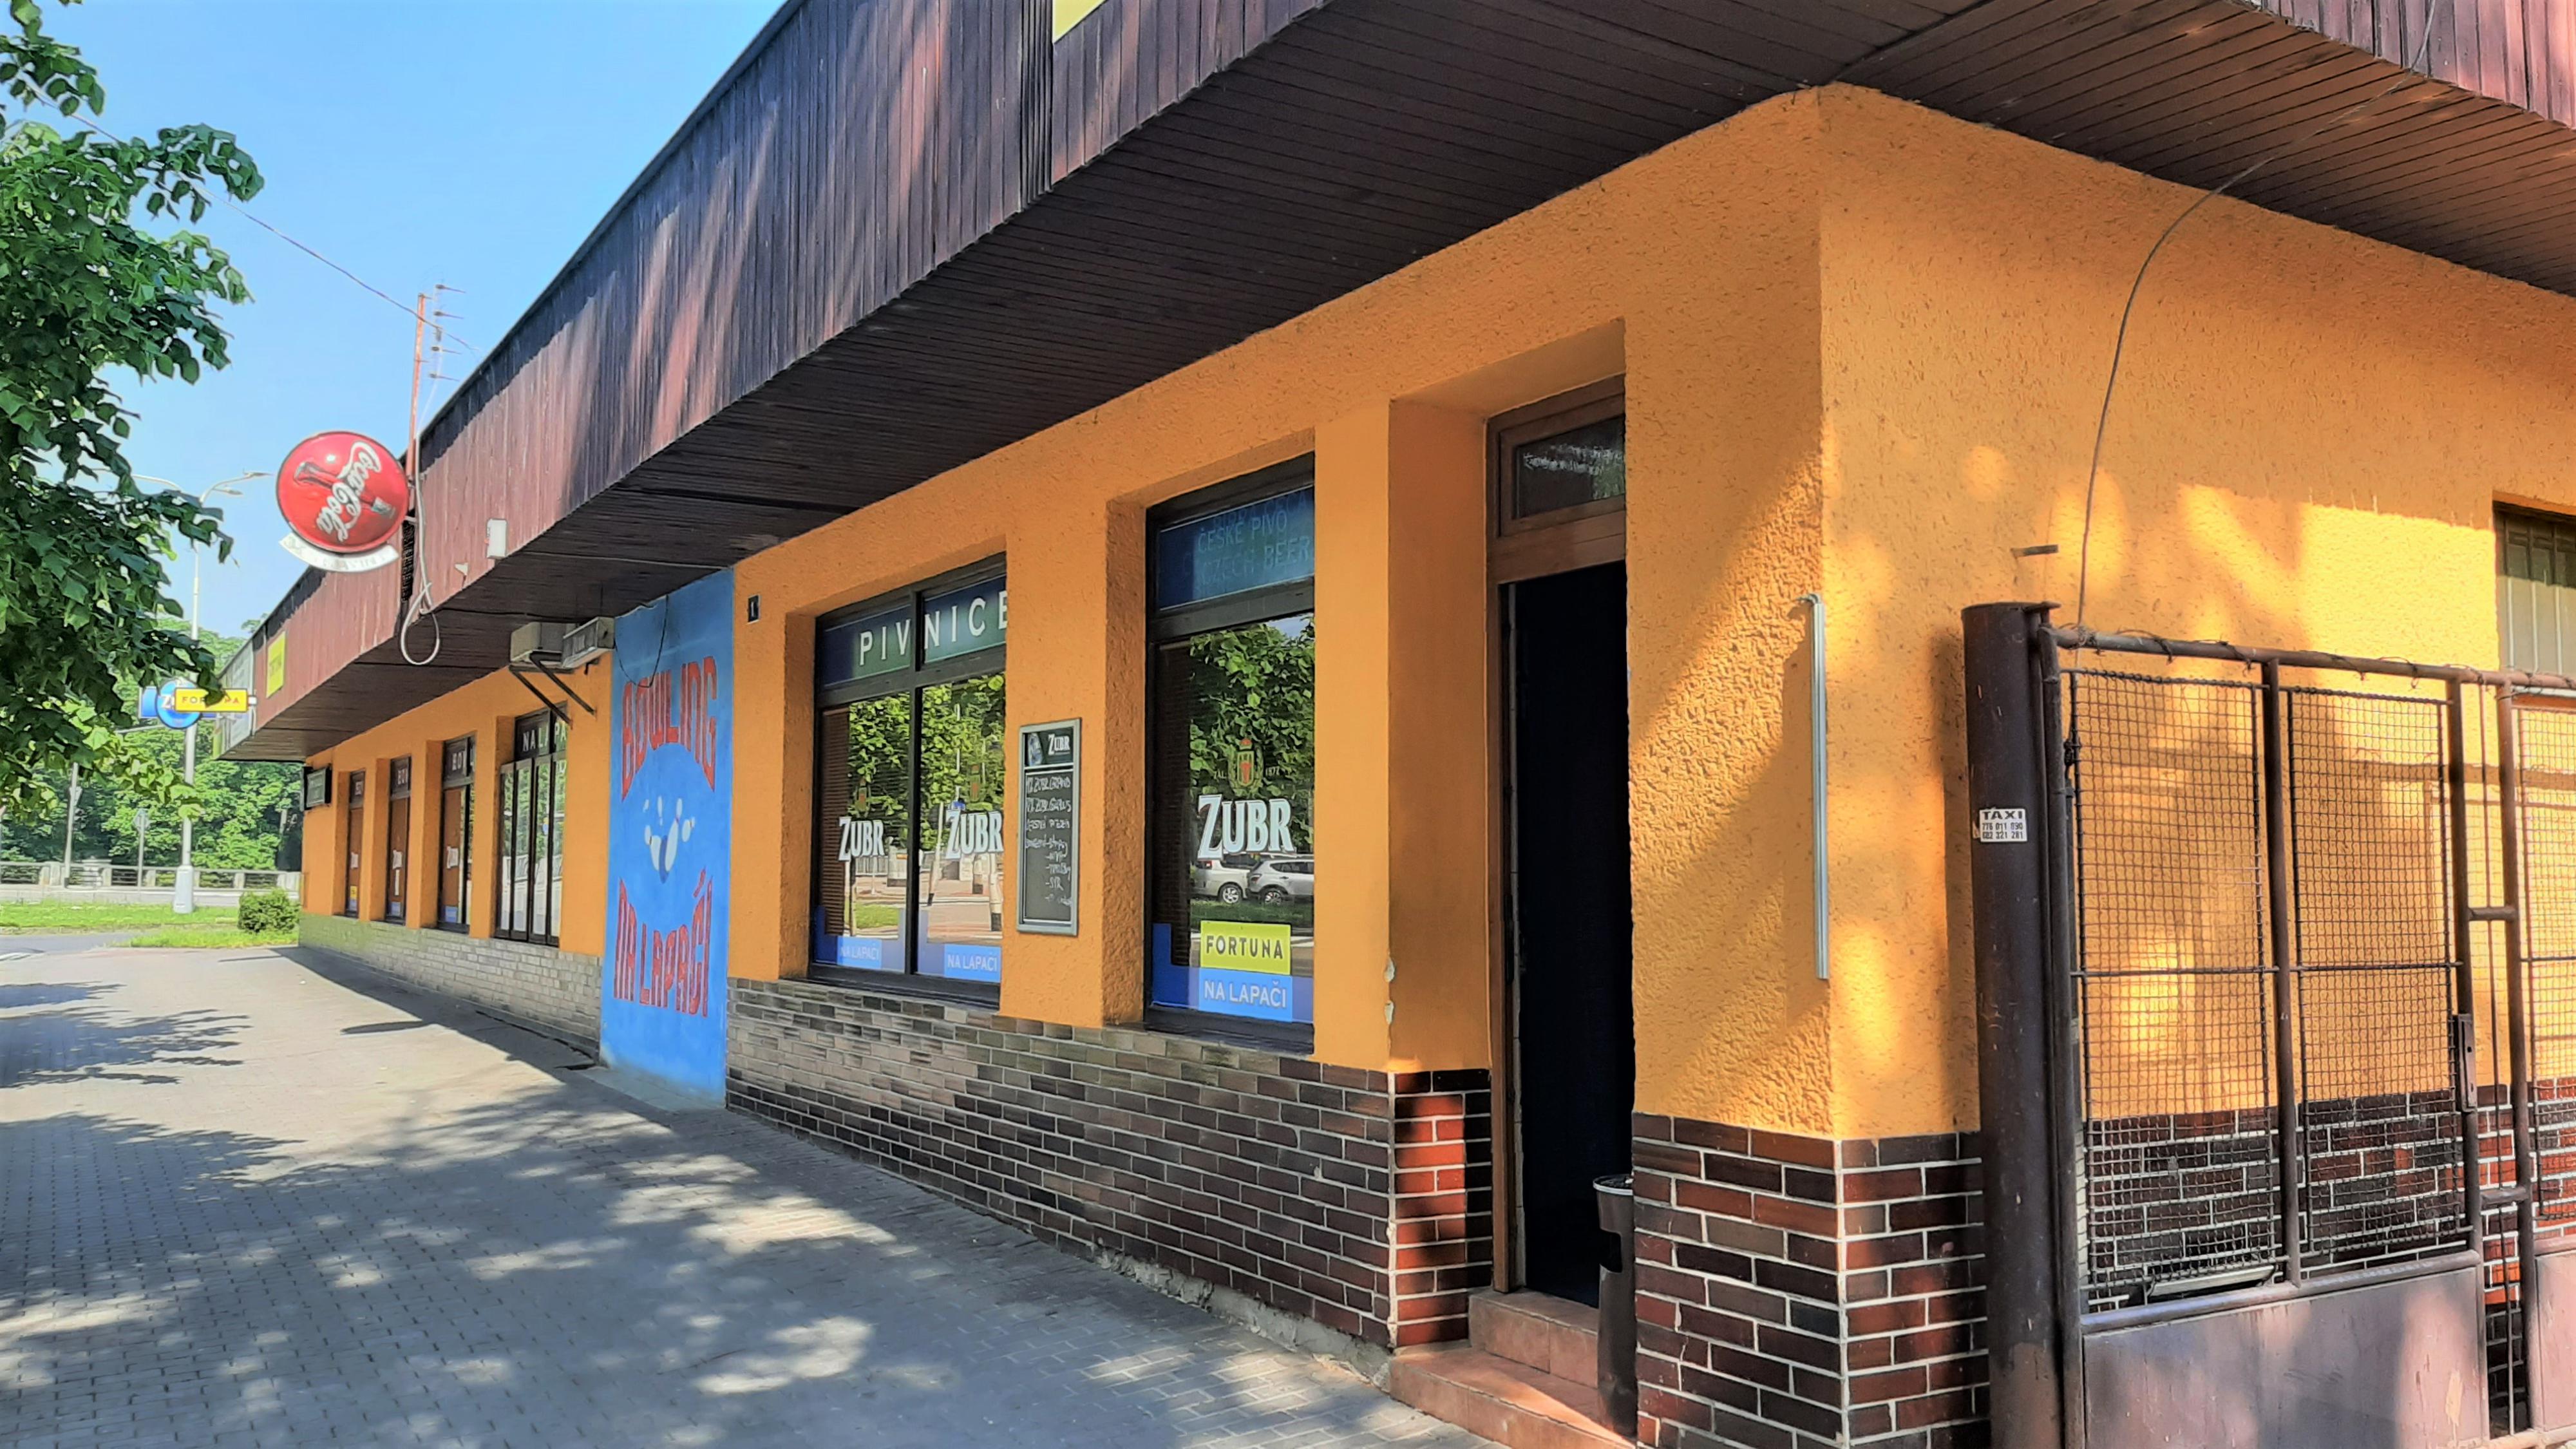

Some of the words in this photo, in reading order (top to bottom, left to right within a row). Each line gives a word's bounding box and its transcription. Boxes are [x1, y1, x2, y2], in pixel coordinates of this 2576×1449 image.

[316, 440, 381, 542] Coca-Cola
[1251, 509, 1287, 540] PIVO
[1264, 536, 1310, 569] BEER
[858, 590, 1008, 666] PIVNICE
[523, 730, 536, 752] NA
[621, 656, 717, 802] BOWLING
[1048, 734, 1070, 755] ZUBR
[1197, 793, 1296, 860] ZUBR
[1982, 811, 2023, 820] TAXI
[838, 816, 886, 861] ZUBR
[945, 810, 1004, 860] ZUBR
[613, 877, 637, 1002] NA
[840, 946, 850, 958] NA
[1206, 935, 1283, 960] FORTUNA
[947, 954, 961, 968] NA
[1204, 980, 1226, 1001] NA
[1229, 980, 1286, 1008] LAPAČI
